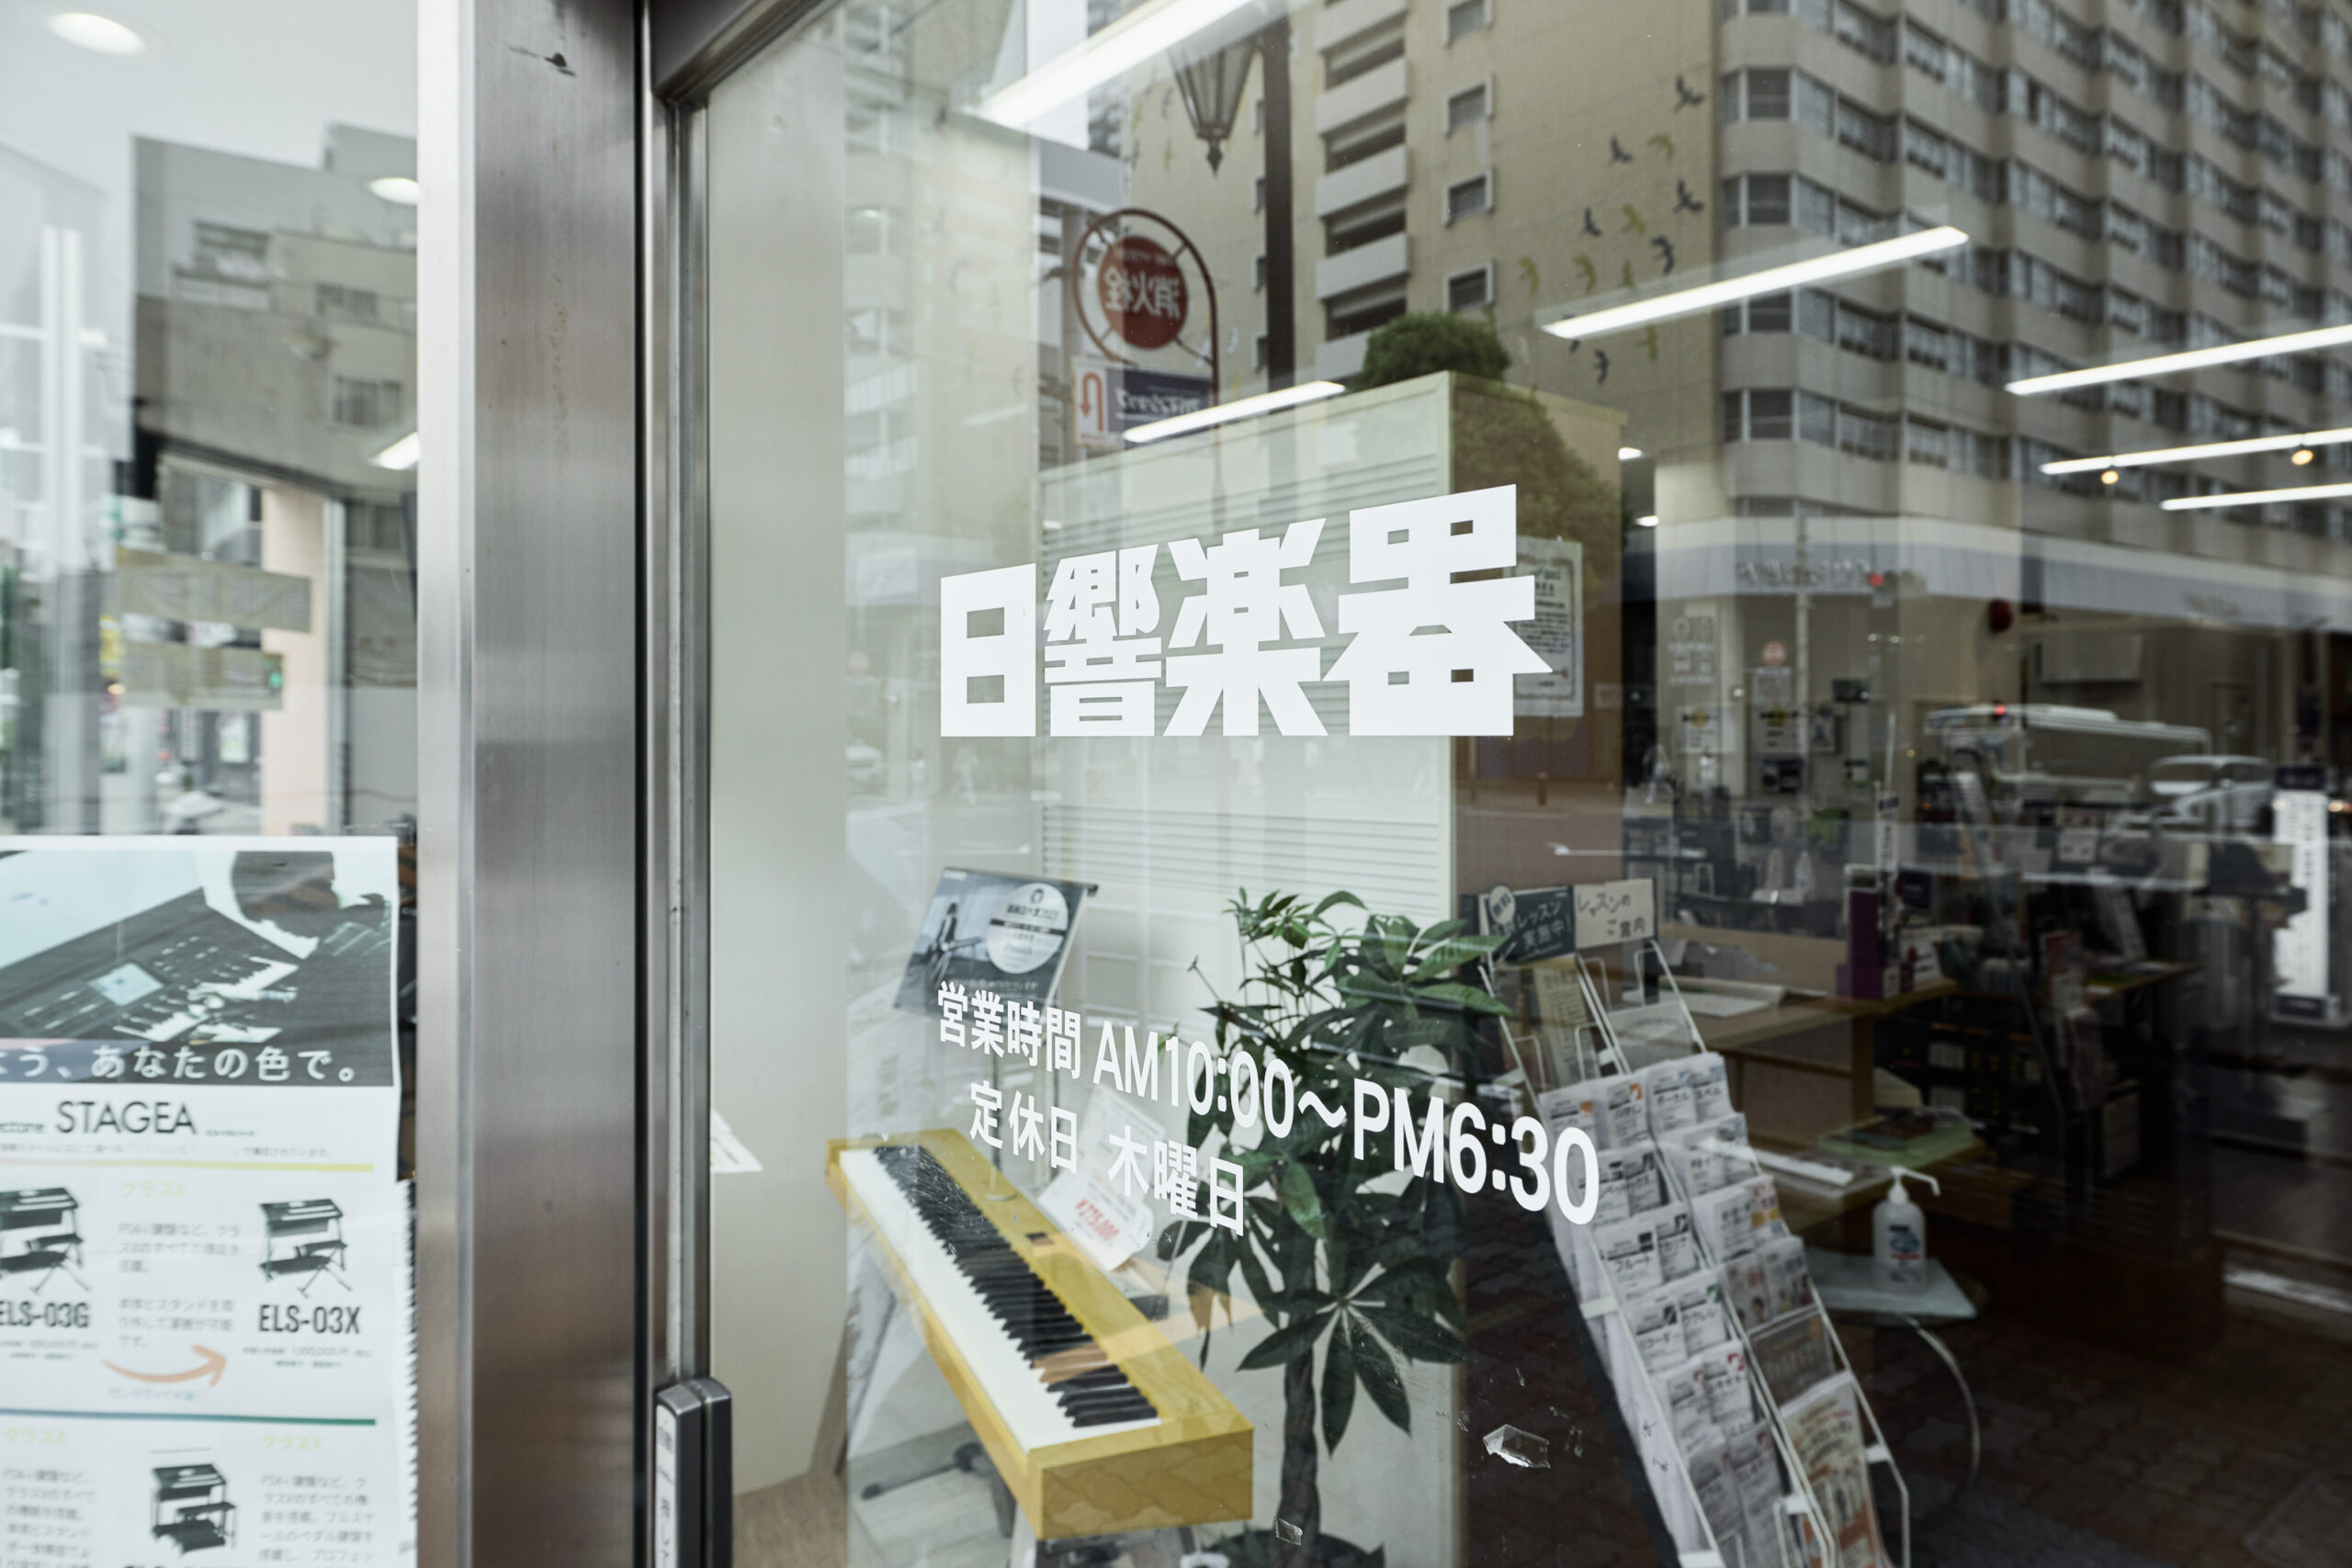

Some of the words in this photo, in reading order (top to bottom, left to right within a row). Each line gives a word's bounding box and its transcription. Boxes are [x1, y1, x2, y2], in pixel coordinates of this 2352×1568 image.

[941, 484, 1553, 737] 日響楽器
[938, 981, 1081, 1079] 営業時間
[56, 1100, 198, 1134] STAGEA
[970, 1081, 1077, 1174] 定休日
[1108, 1126, 1244, 1236] 木曜日
[259, 1304, 361, 1334] ELS-03X
